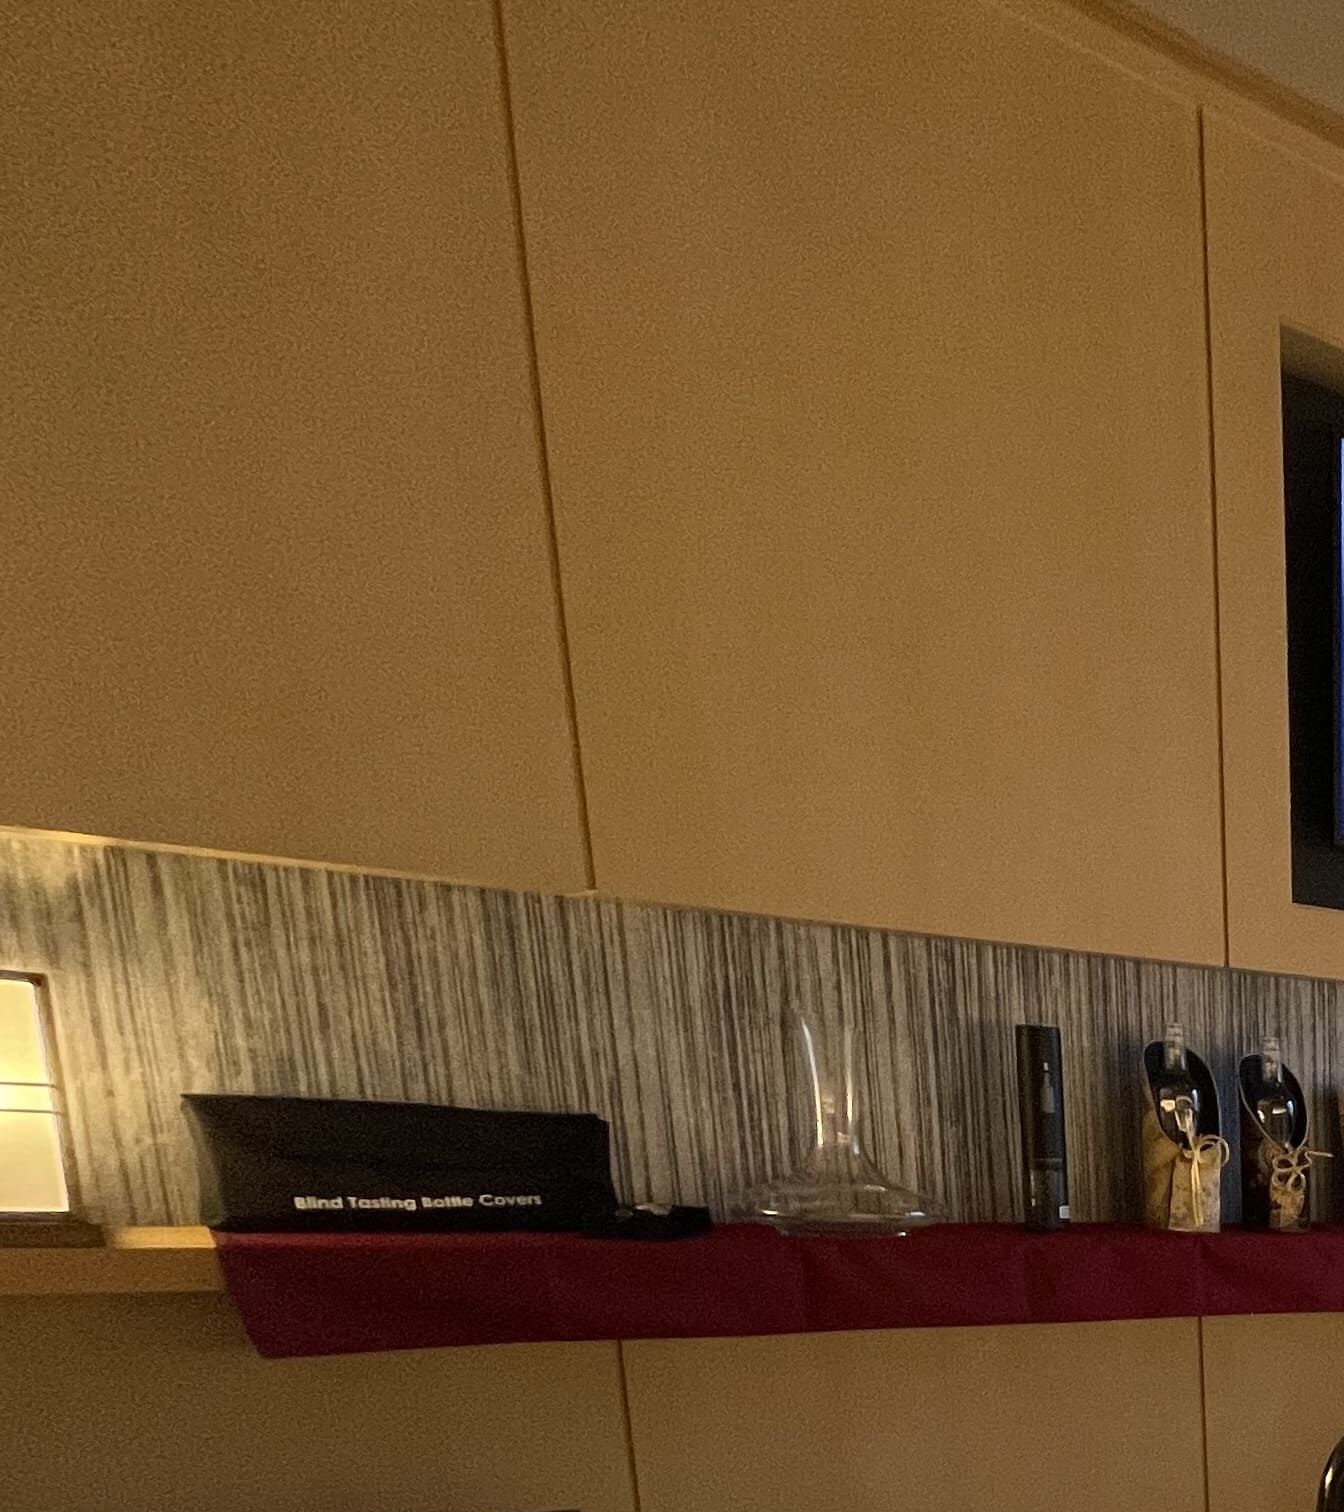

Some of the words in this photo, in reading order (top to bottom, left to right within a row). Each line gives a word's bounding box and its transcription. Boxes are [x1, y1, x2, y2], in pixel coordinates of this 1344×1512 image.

[293, 1196, 344, 1210] Blind
[346, 1196, 416, 1211] Tasting
[421, 1195, 474, 1208] Bottle
[478, 1193, 543, 1206] Covers
